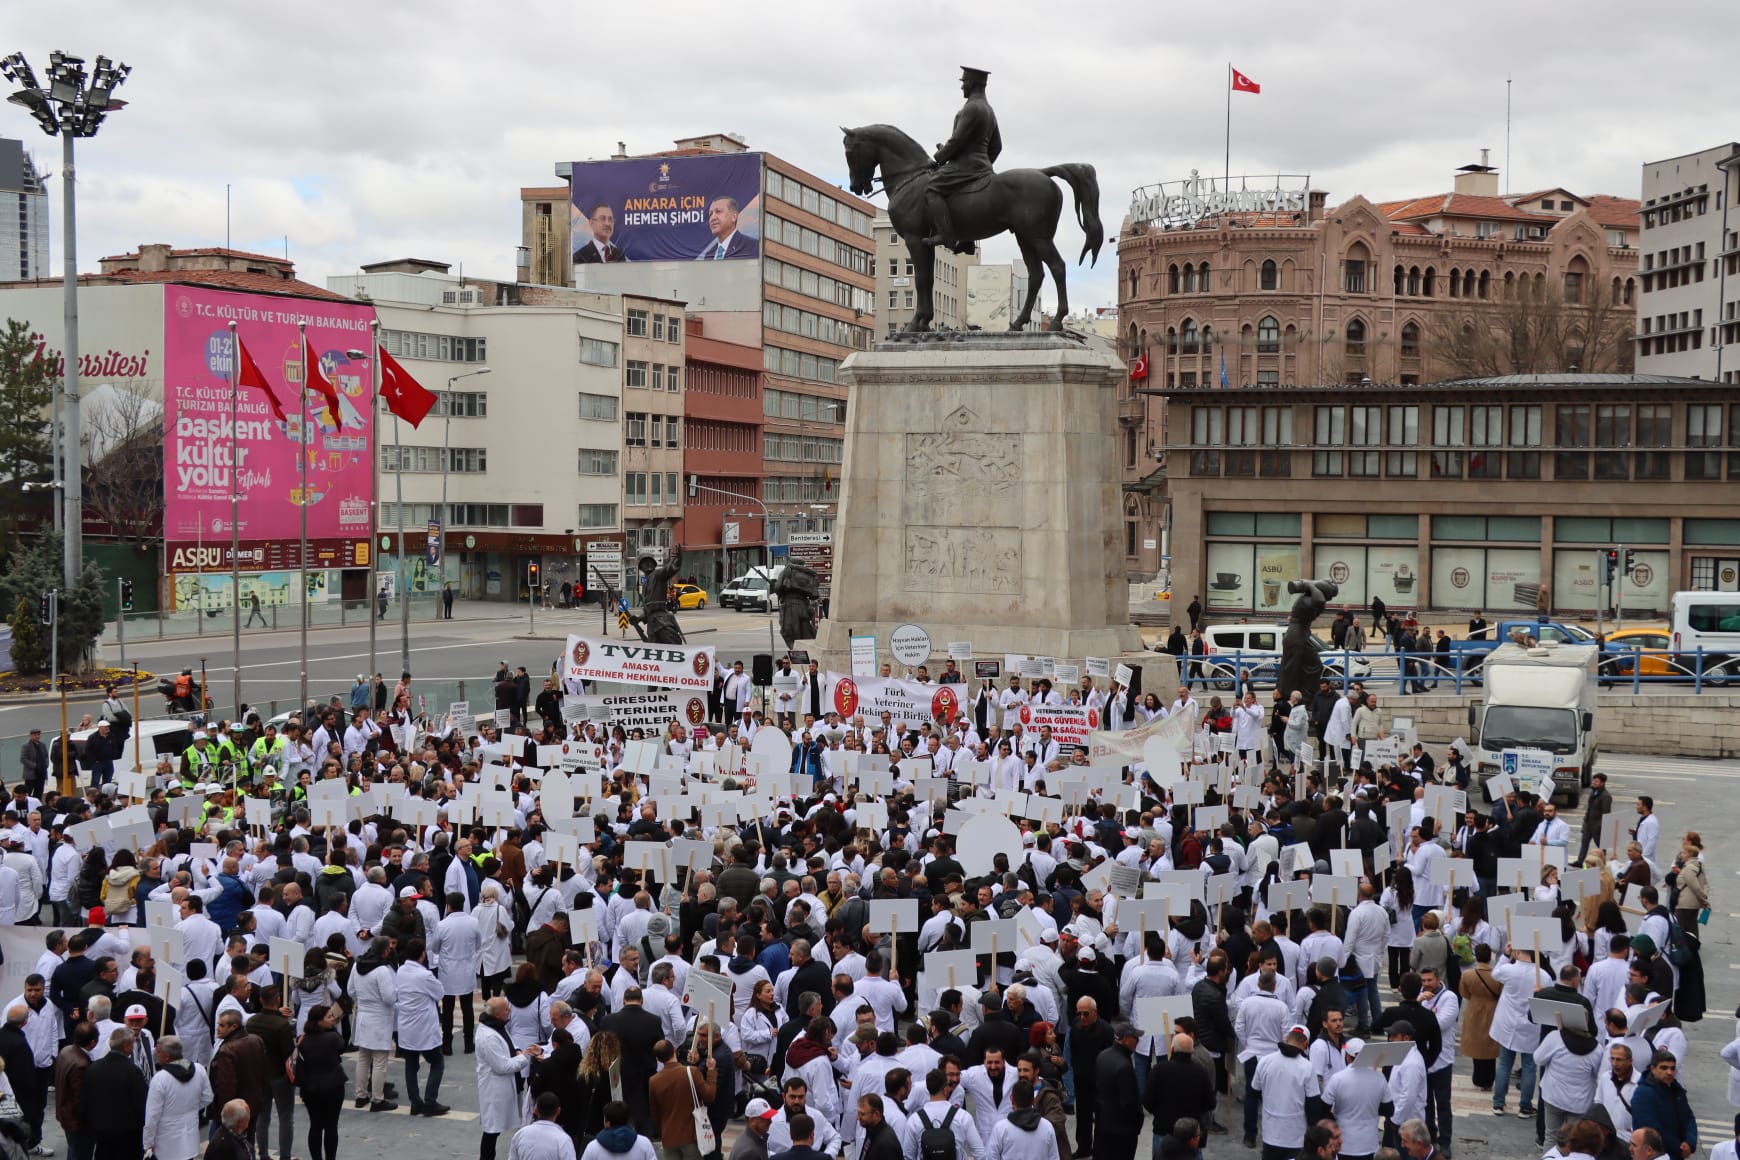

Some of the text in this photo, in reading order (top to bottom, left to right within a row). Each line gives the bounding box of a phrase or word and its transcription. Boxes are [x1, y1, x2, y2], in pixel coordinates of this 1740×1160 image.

[624, 195, 705, 211] ANKARA İÇİN
[1207, 187, 1310, 214] BANKASI
[624, 210, 704, 227] HEMEN ŞİMDİ
[195, 303, 367, 332] T.C. KÜLTÜR VE TURİZM BAKANLIĞI
[176, 386, 194, 398] T.C.
[236, 391, 248, 401] VE
[176, 398, 215, 412] TURİZM
[177, 411, 272, 441] başkent
[177, 466, 230, 492] yolu
[172, 547, 221, 567] ASBÜ
[600, 644, 686, 662] TVHB
[622, 661, 661, 673] AMASYA
[570, 667, 709, 687] VETERİNER HEKİMLERİ ODASI
[602, 694, 668, 705] GİRESUN
[884, 687, 906, 697] Türk
[874, 697, 915, 709] Veteriner
[903, 710, 932, 722] Birliği
[1034, 716, 1053, 725] GIDA
